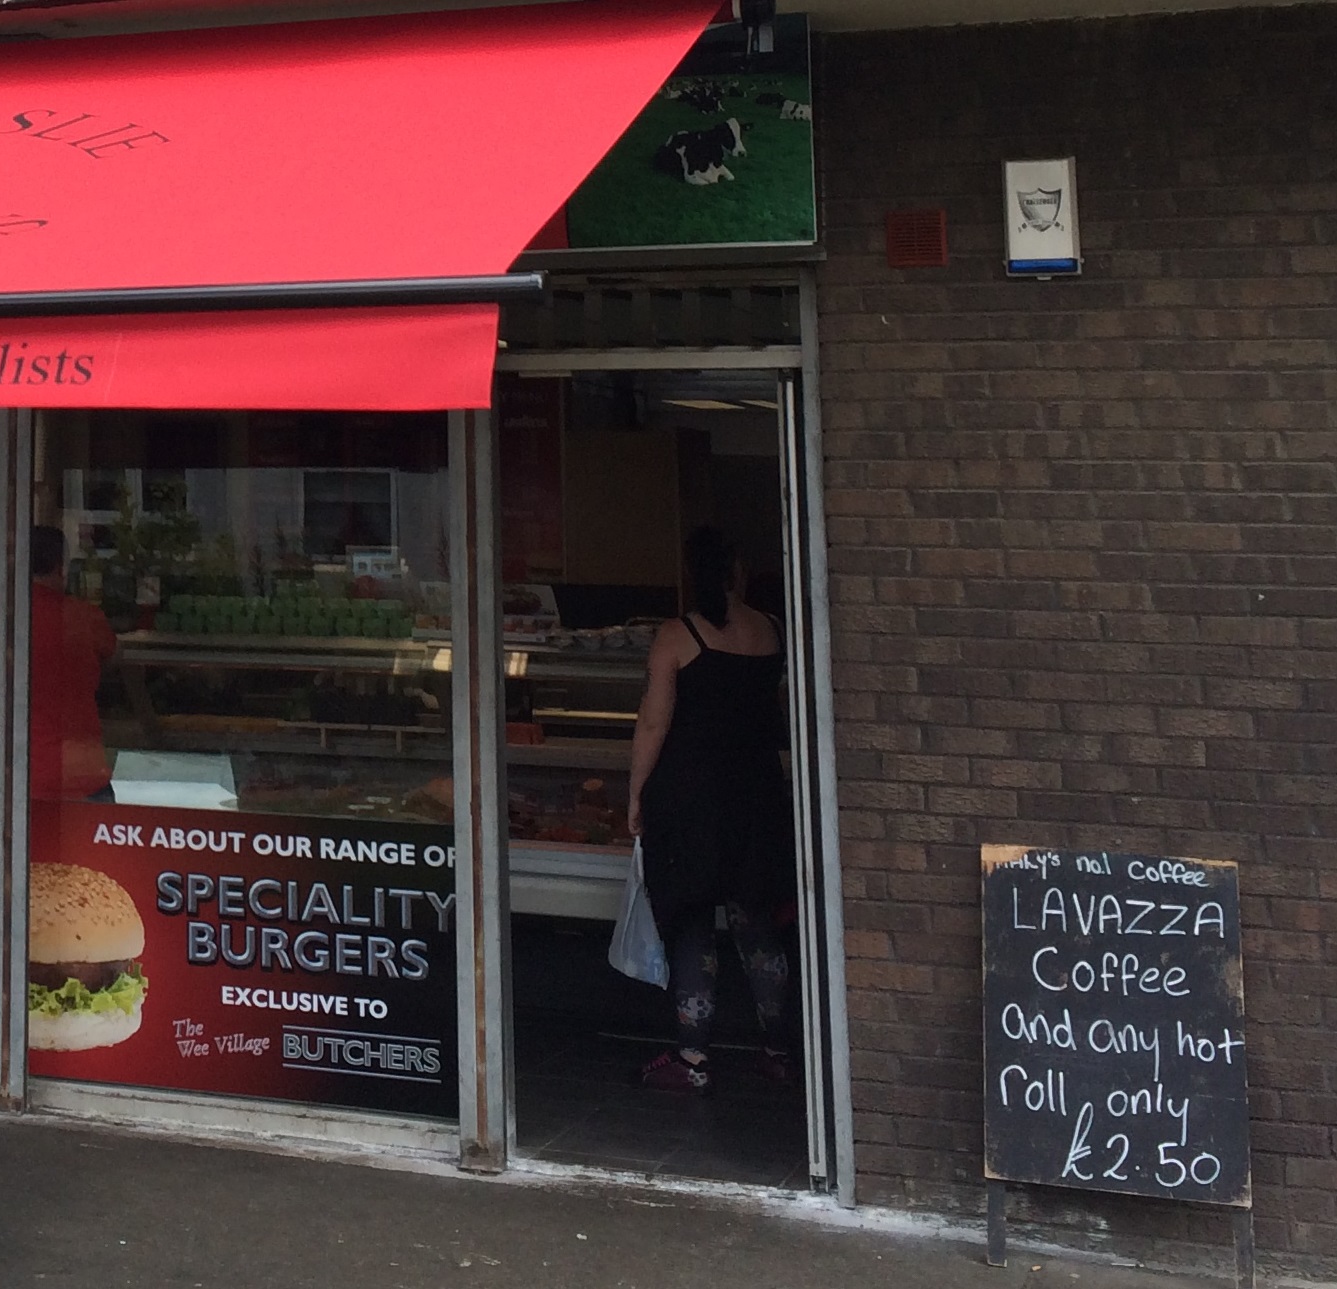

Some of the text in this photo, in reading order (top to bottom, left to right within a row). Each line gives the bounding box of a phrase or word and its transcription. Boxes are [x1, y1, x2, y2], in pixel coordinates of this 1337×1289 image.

[93, 823, 143, 848] ASK
[150, 827, 246, 854] ABOUT
[252, 833, 312, 859] OUR
[320, 837, 416, 868] RANGE
[156, 870, 457, 934] SPECIALITY
[1012, 886, 1226, 939] LAVAZZA
[187, 921, 430, 981] BURGERS
[1032, 945, 1191, 997] Coffee
[172, 1018, 204, 1038] The
[221, 985, 388, 1019] EXCLUSIVE TO
[176, 1033, 271, 1058] Wee Village
[282, 1033, 441, 1075] BUTCHERS
[1001, 1002, 1246, 1084] and any hot
[1106, 1082, 1191, 1147] only
[1060, 1100, 1222, 1188] £2.50
